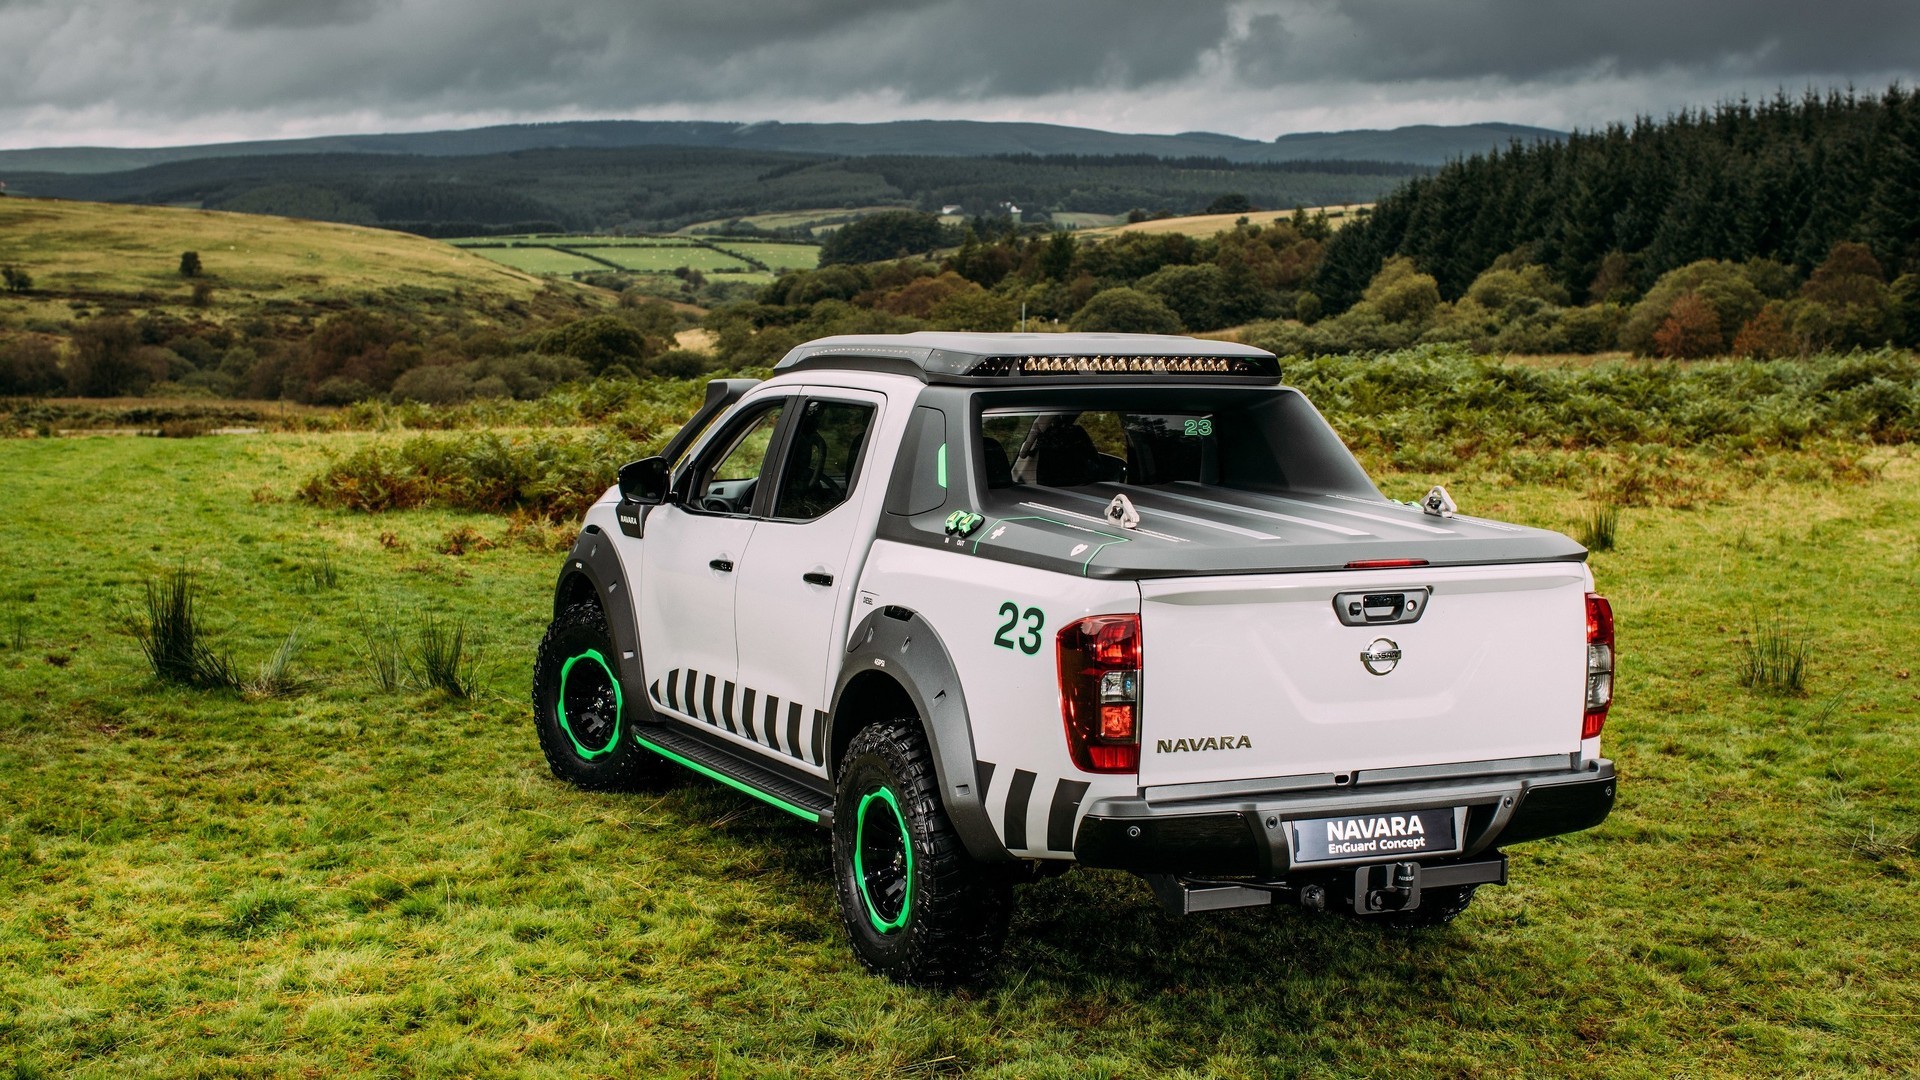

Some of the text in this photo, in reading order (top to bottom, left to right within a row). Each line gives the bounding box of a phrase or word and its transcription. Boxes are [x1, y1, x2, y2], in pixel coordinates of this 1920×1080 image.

[1184, 419, 1212, 436] 23
[620, 514, 638, 525] NAVARA
[993, 600, 1045, 656] 23
[1156, 734, 1252, 754] NAVARA
[1326, 815, 1425, 842] NAVARA
[1328, 836, 1426, 854] EnGuard Concept
